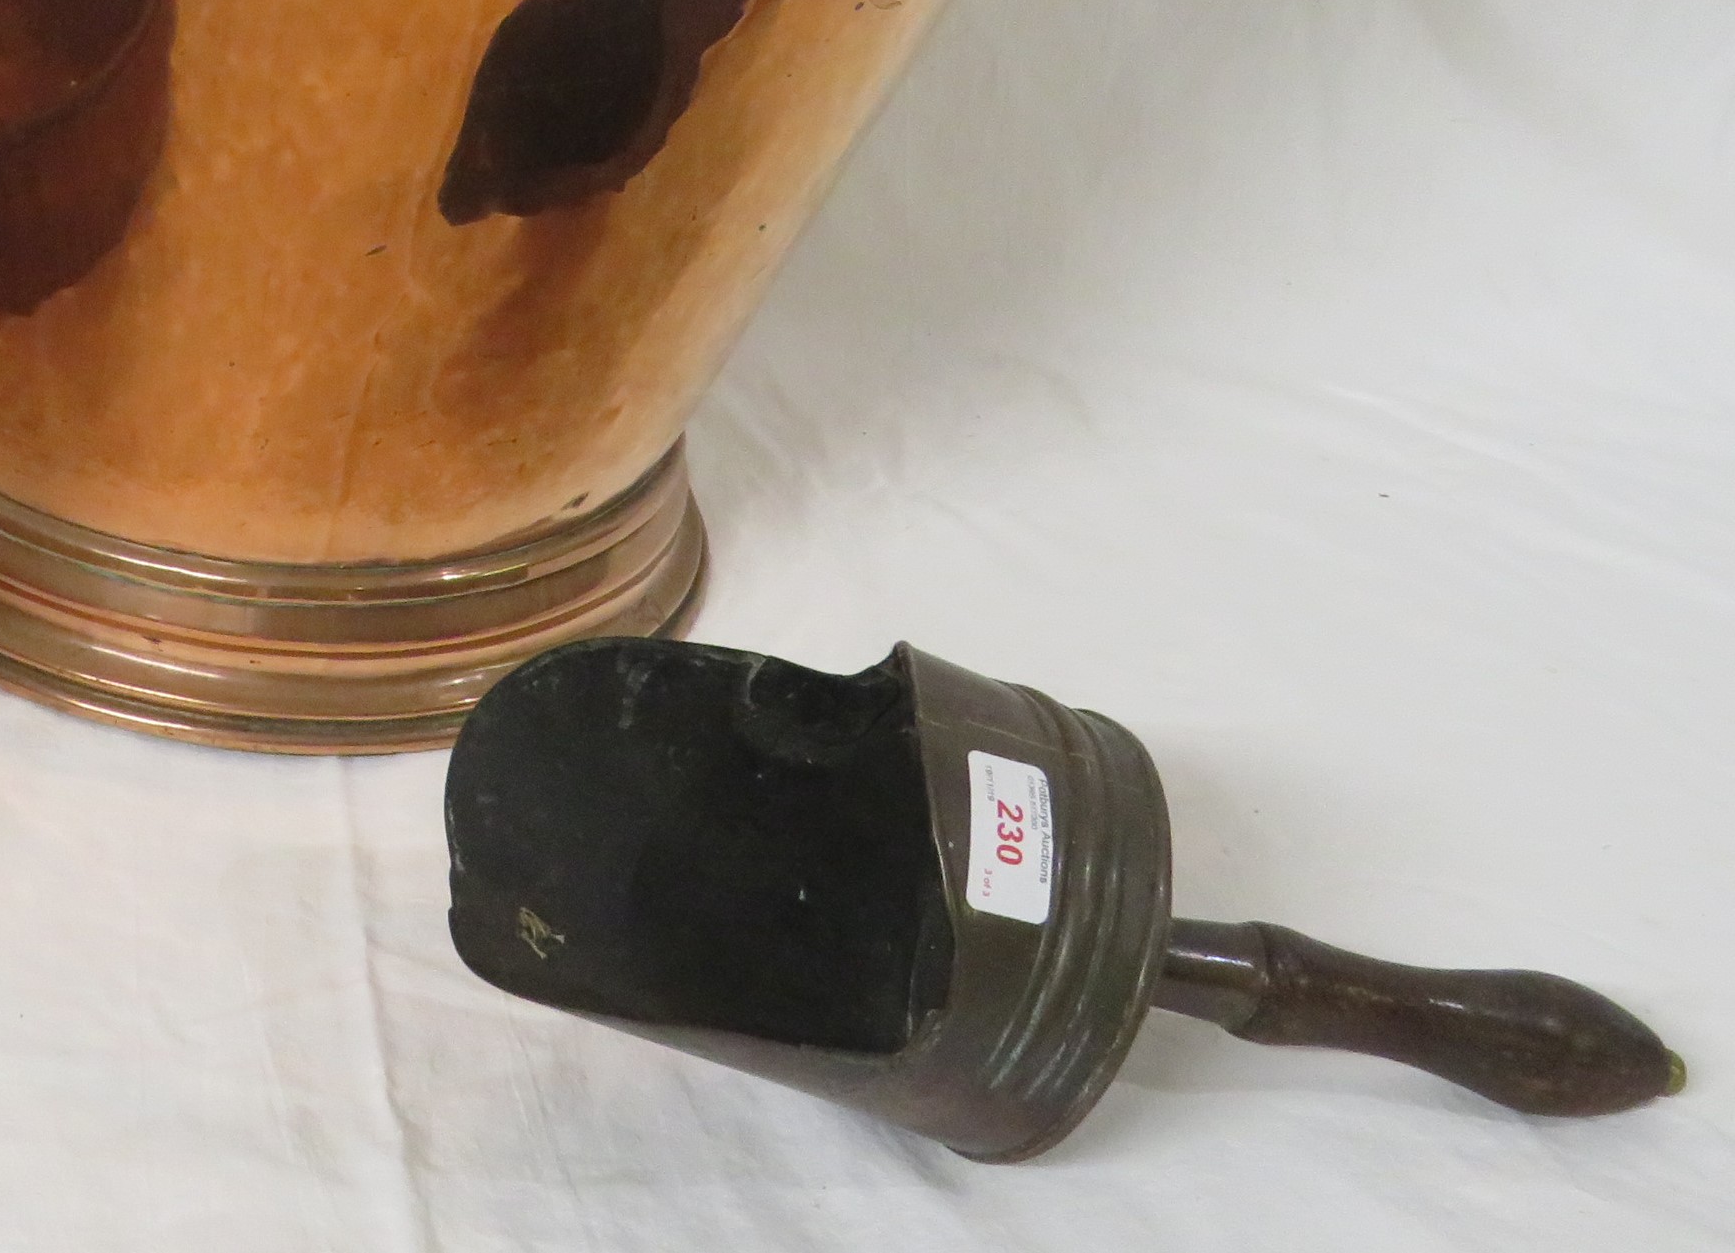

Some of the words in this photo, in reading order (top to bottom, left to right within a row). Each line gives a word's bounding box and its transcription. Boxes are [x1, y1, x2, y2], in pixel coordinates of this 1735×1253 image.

[1038, 779, 1049, 828] Potburys
[996, 800, 1024, 865] 230
[1039, 831, 1051, 884] Auctions
[984, 877, 992, 889] of
